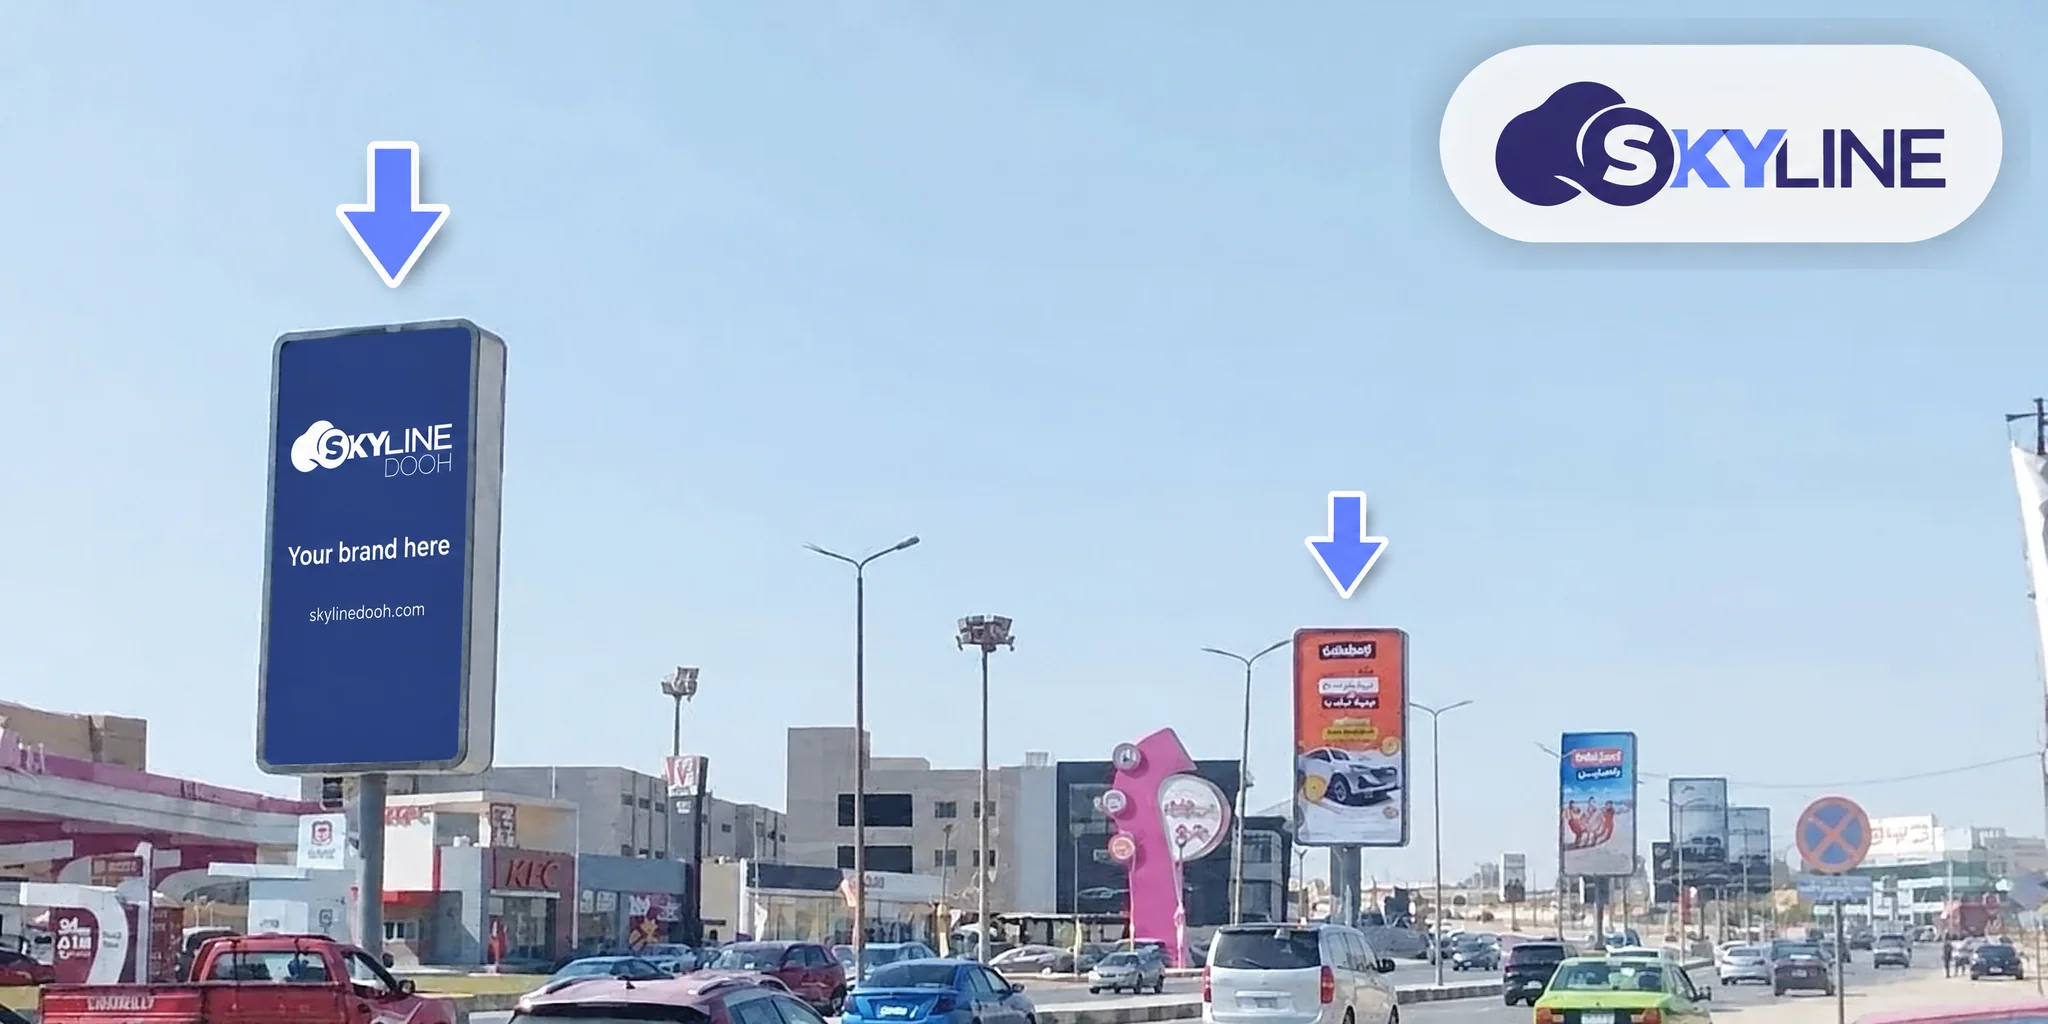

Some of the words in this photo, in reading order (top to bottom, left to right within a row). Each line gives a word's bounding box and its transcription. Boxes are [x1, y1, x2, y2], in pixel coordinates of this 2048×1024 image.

[325, 423, 453, 460] SKYLINE
[384, 452, 452, 478] DOOH
[288, 545, 333, 567] Your
[338, 537, 397, 563] brand
[404, 536, 450, 558] here
[309, 604, 425, 625] skylinedooh.com
[506, 859, 559, 889] KFC
